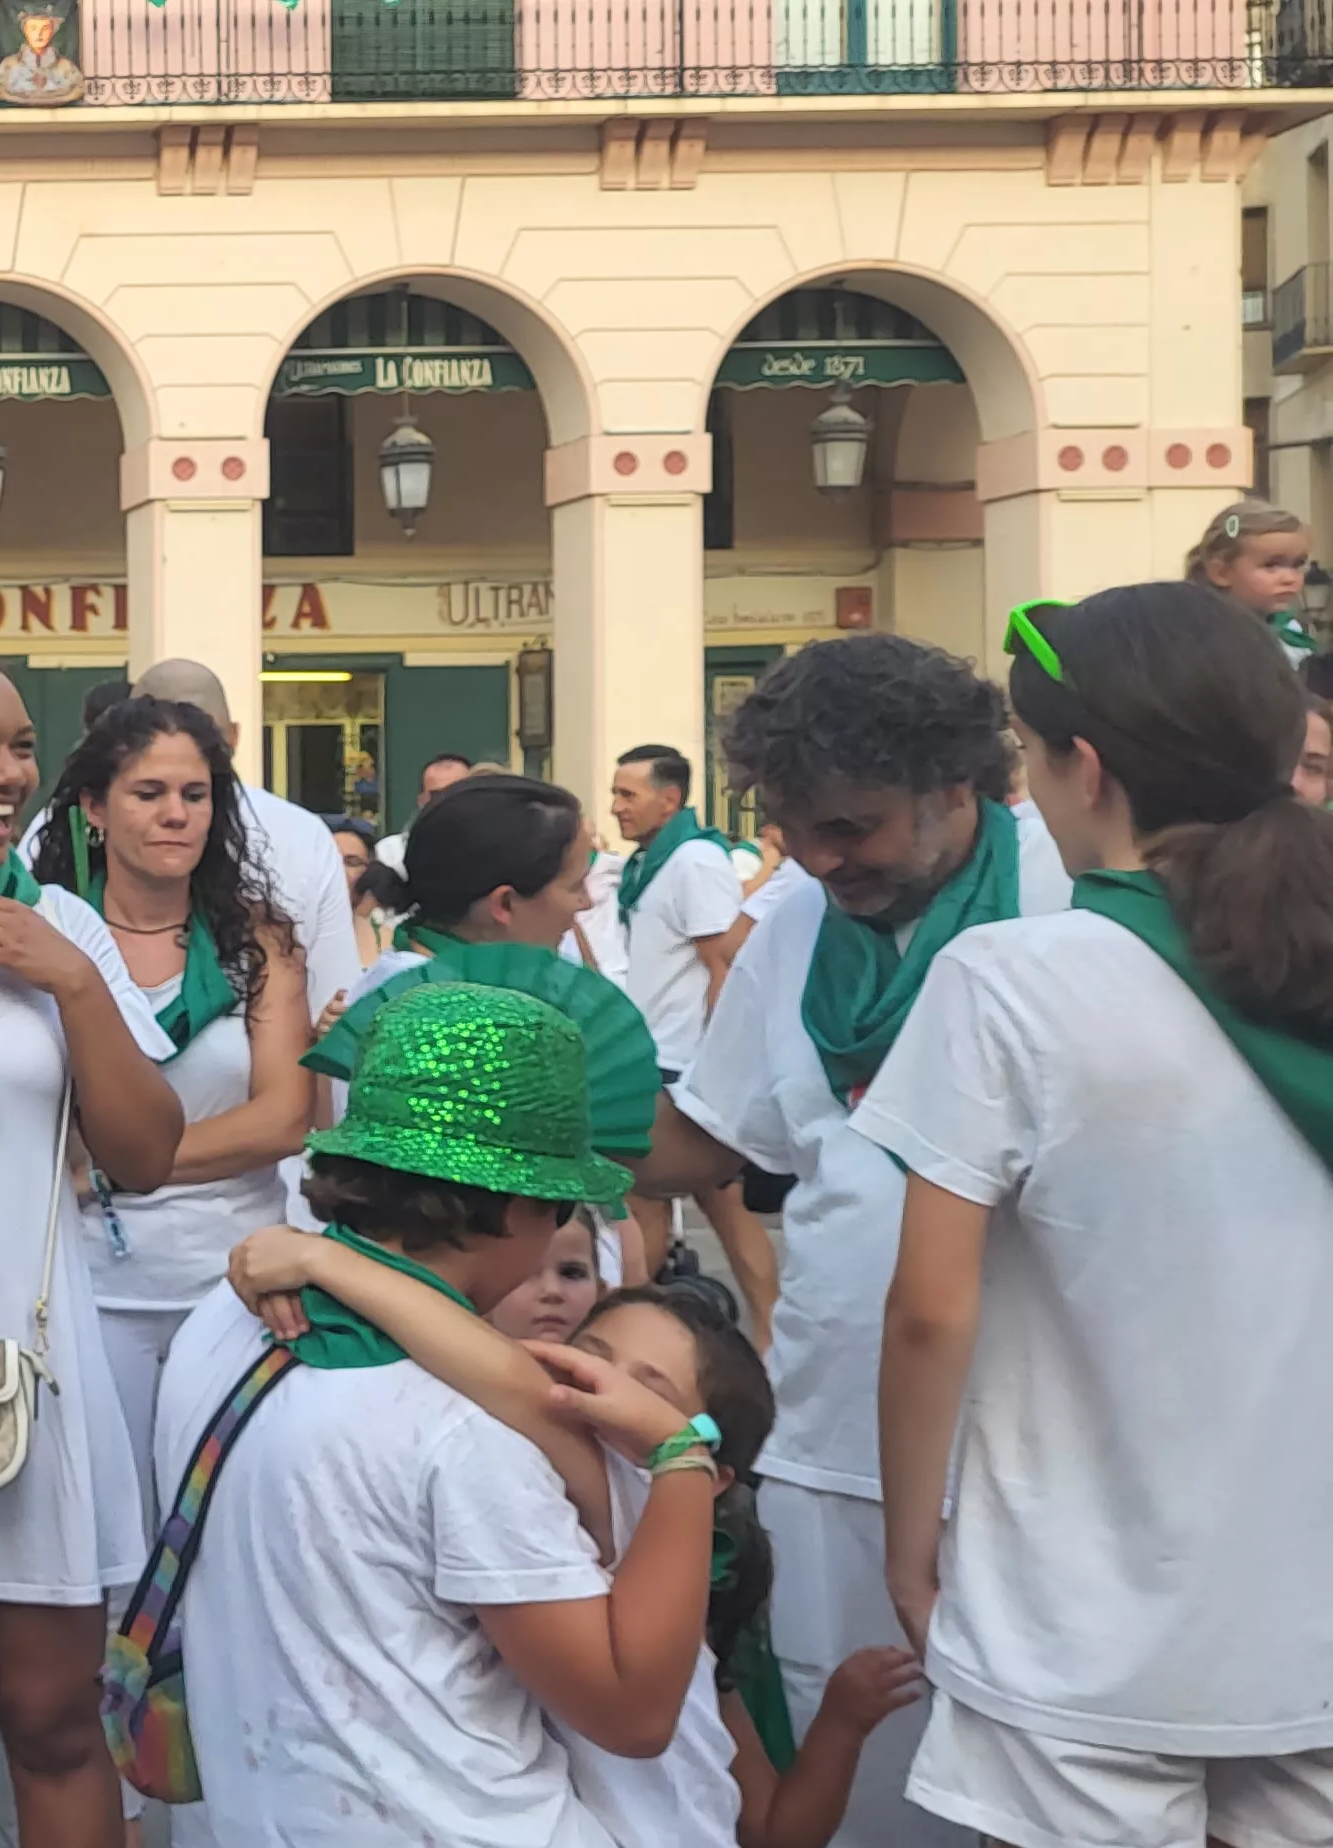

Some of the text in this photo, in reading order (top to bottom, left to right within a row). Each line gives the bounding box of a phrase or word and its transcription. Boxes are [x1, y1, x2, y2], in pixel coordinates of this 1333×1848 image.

[375, 356, 399, 388] LA
[402, 356, 493, 388] CONFIANZA
[761, 352, 817, 376] desde
